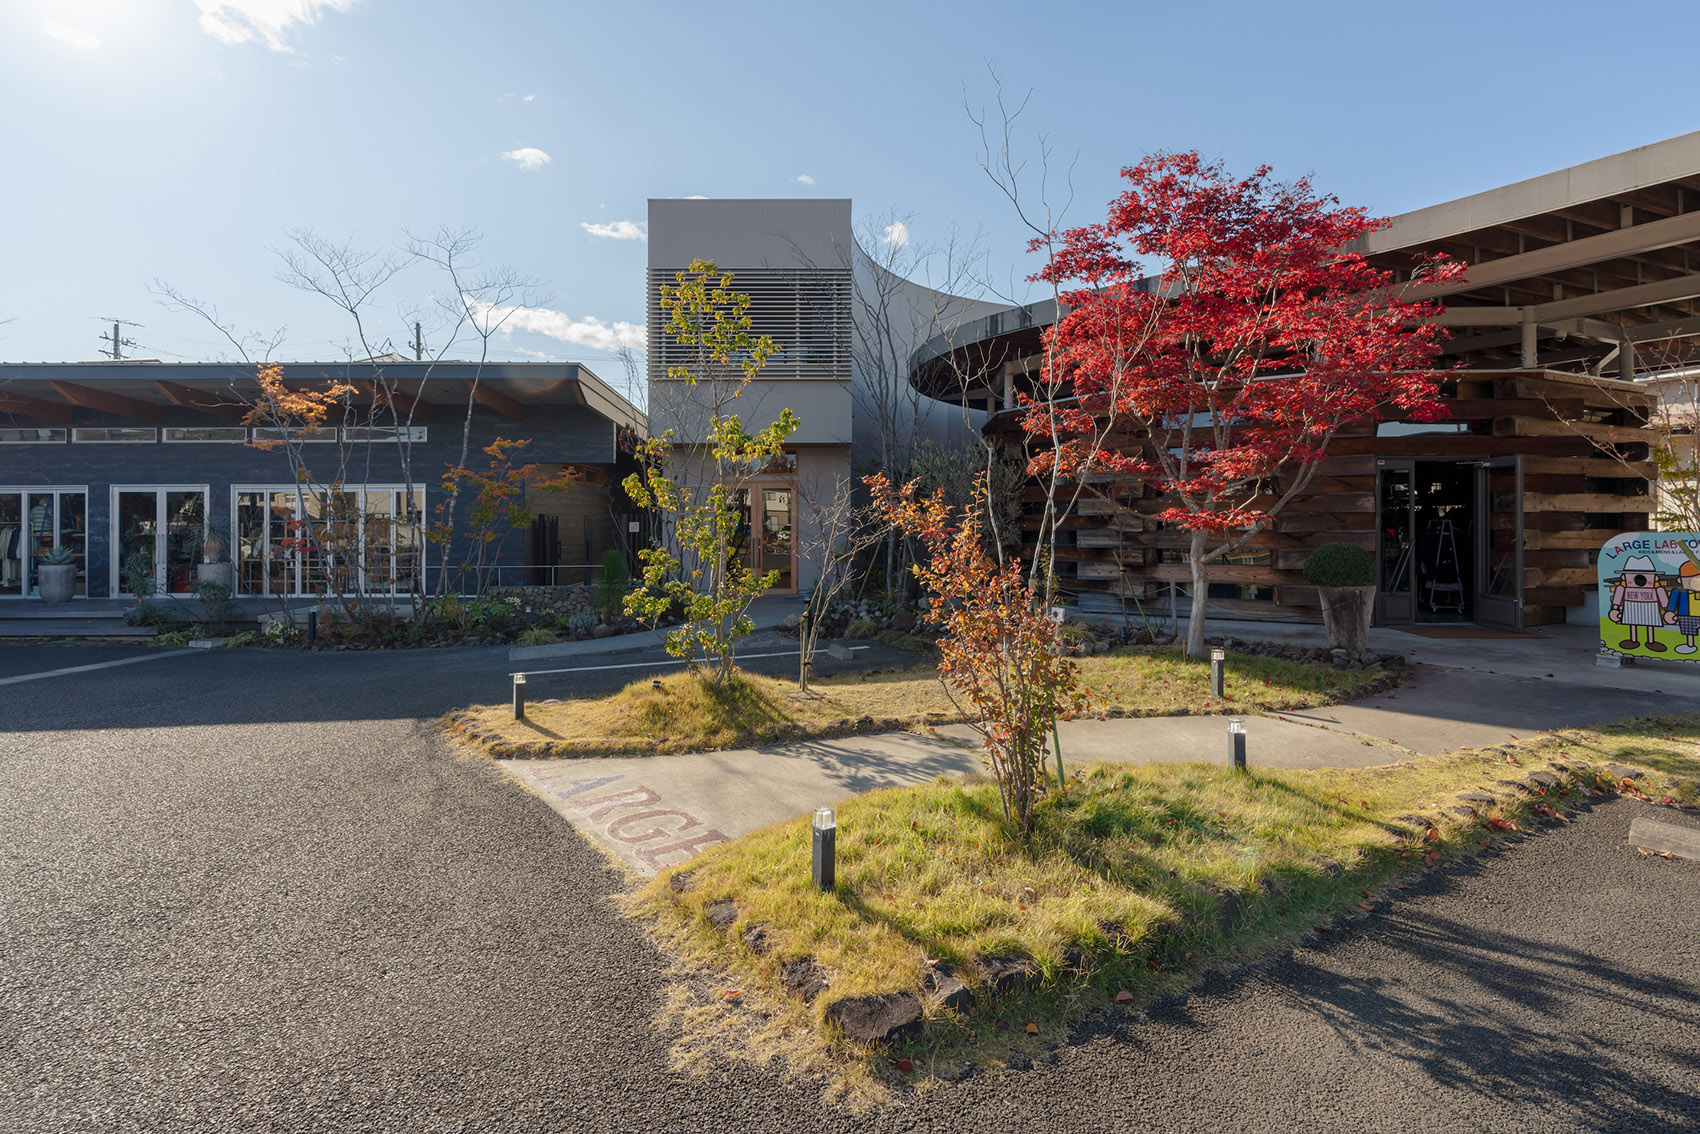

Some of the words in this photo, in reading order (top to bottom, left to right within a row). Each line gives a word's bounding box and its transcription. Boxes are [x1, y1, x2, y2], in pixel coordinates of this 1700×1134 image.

[1606, 540, 1650, 559] LARGE
[1654, 540, 1678, 549] LAB
[1627, 591, 1639, 600] NEW
[1640, 591, 1654, 600] YORK
[527, 758, 728, 872] LARGE
